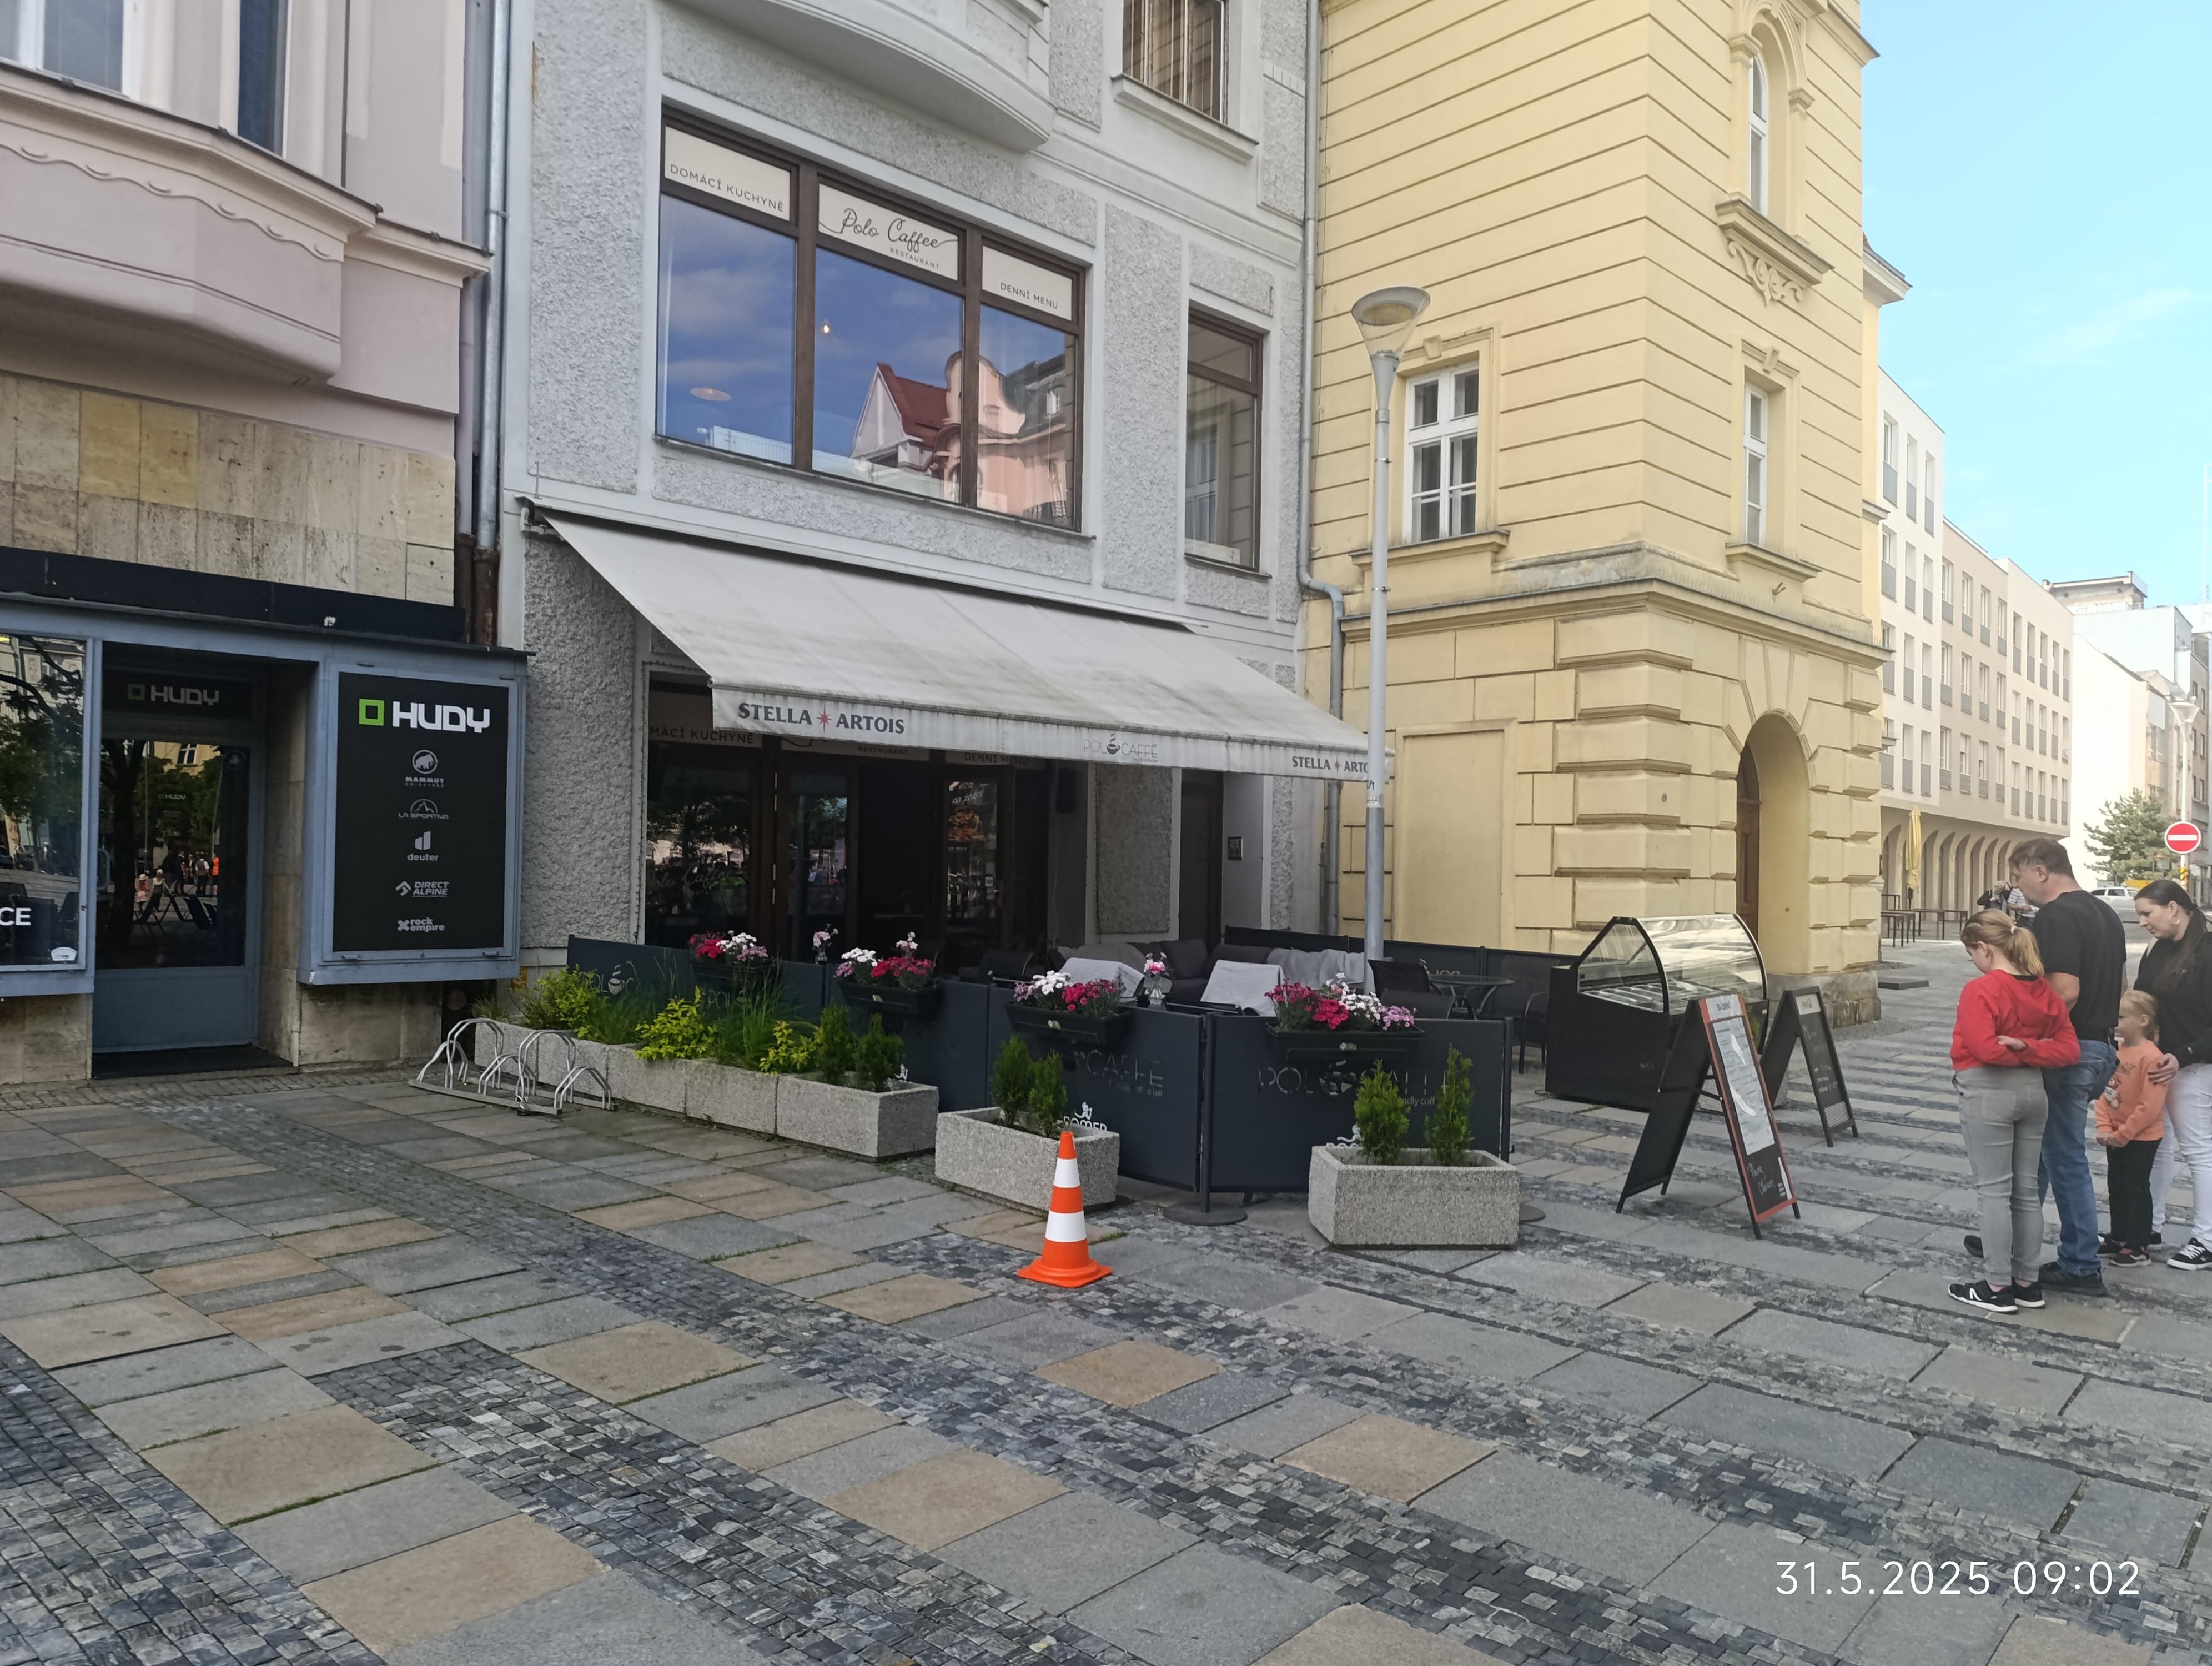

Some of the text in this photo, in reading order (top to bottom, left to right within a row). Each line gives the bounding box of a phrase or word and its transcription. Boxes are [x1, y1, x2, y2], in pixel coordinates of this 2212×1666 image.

[670, 163, 784, 213] DOMÁCÍ KUCHYNĚ
[836, 208, 944, 253] Polo Caffee
[889, 247, 940, 269] RESTAURANT
[1000, 282, 1058, 309] DENNÍ MENU
[150, 684, 220, 706] HUDY
[392, 701, 490, 734] HUDY
[738, 702, 905, 735] STELLA ARTOIS
[858, 746, 908, 755] RESTAURANT
[1291, 755, 1331, 770] STELLA
[406, 852, 439, 861] deuter
[410, 916, 434, 925] rock
[410, 924, 445, 933] empire
